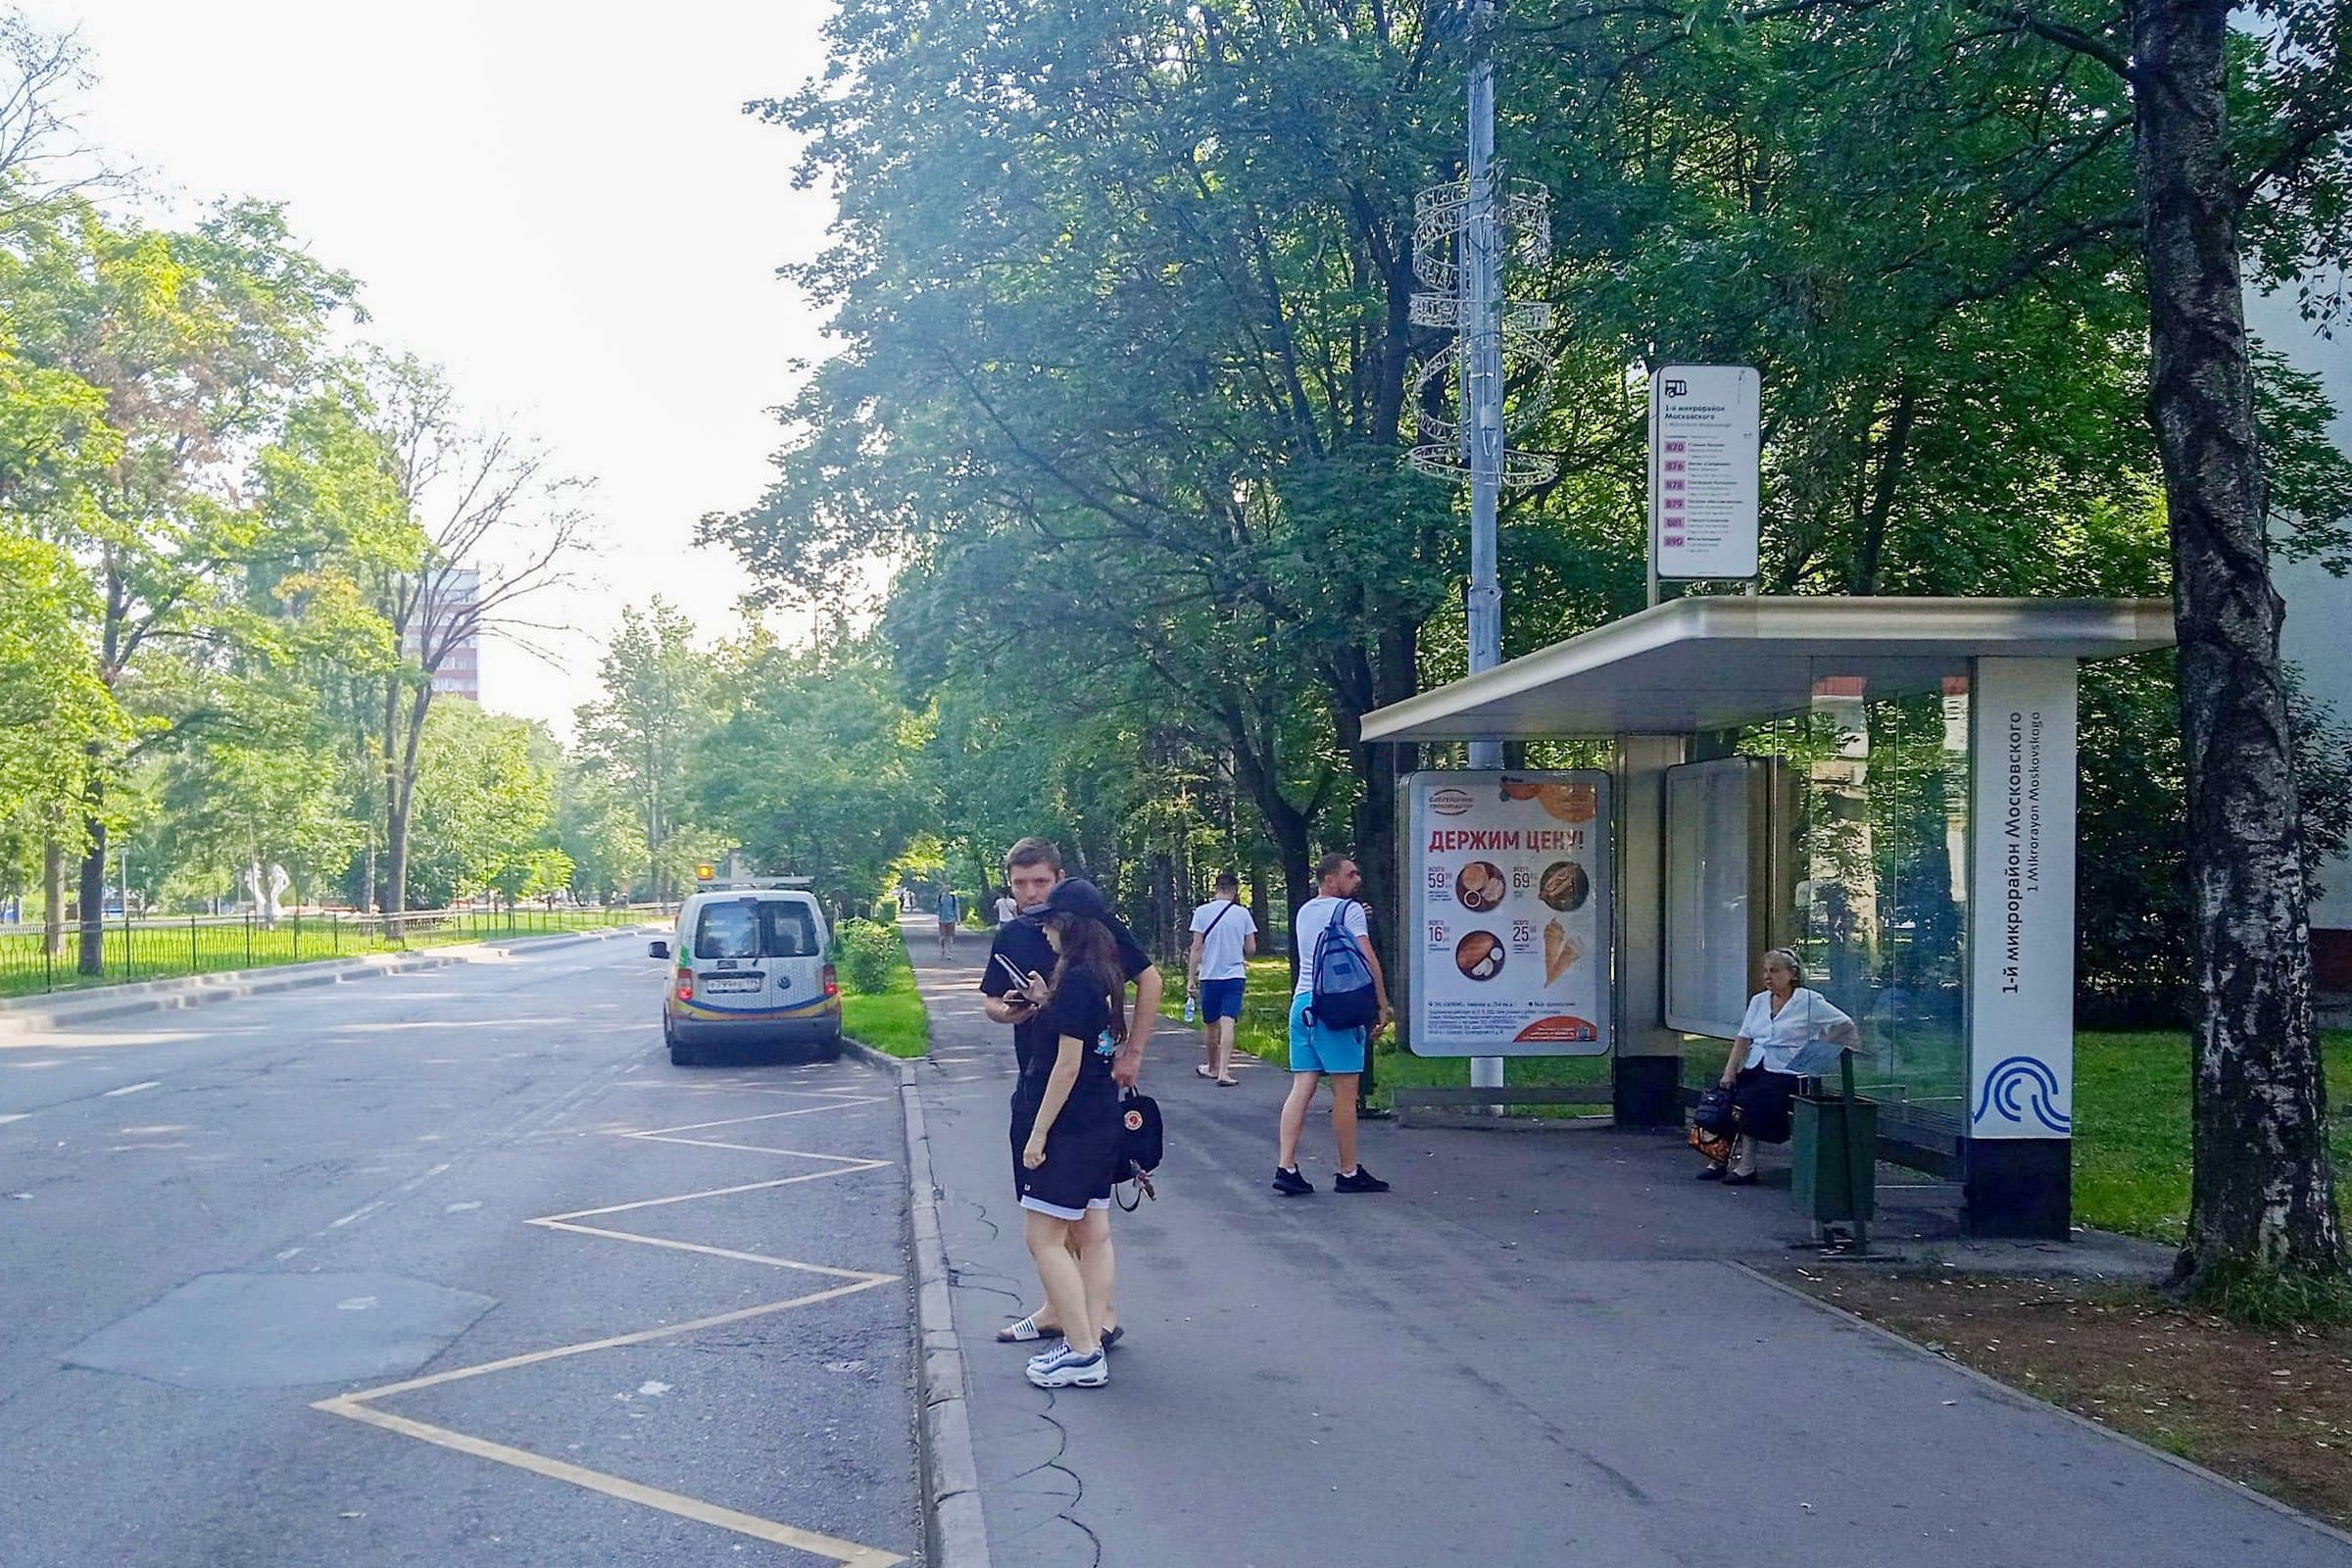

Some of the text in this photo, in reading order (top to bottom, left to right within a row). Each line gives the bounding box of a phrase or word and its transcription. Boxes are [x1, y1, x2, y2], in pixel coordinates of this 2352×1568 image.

[2028, 711, 2043, 802] Moskovskogo
[1429, 830, 1584, 853] ДЕРЖИМ ЦЕНУ!
[2028, 805, 2041, 882] Mikrorayon
[2003, 711, 2023, 994] 1-й микрорайон Московского
[1428, 872, 1445, 888] 59
[1513, 872, 1530, 888] 69
[1429, 926, 1443, 942] 16
[1513, 926, 1529, 942] 25
